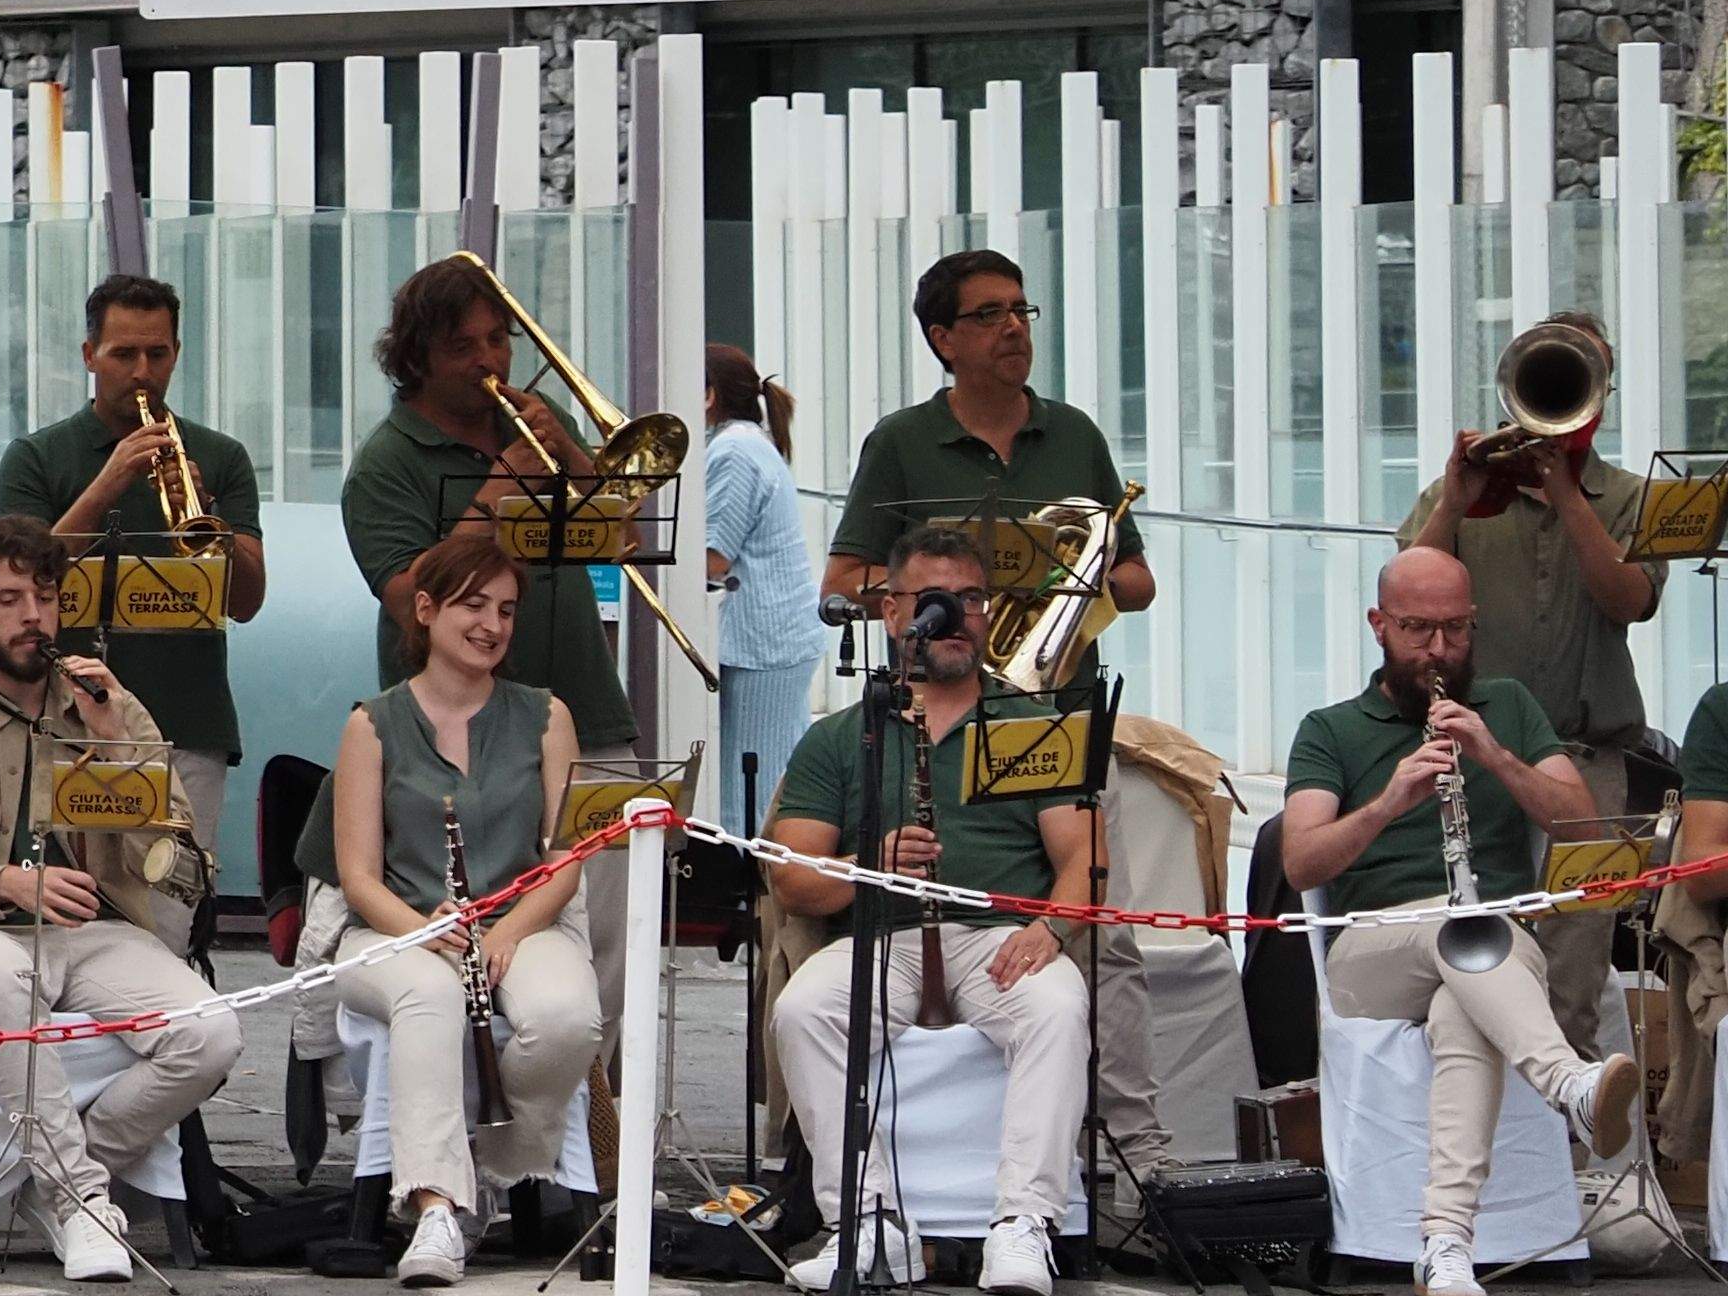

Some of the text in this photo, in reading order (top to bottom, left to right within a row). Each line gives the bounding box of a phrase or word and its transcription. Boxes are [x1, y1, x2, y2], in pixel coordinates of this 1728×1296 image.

[524, 529, 574, 538] CIUT
[524, 539, 595, 547] TERSSA
[127, 604, 199, 614] TERRASSA
[1042, 752, 1059, 762] DE
[69, 804, 142, 815] TERRASS
